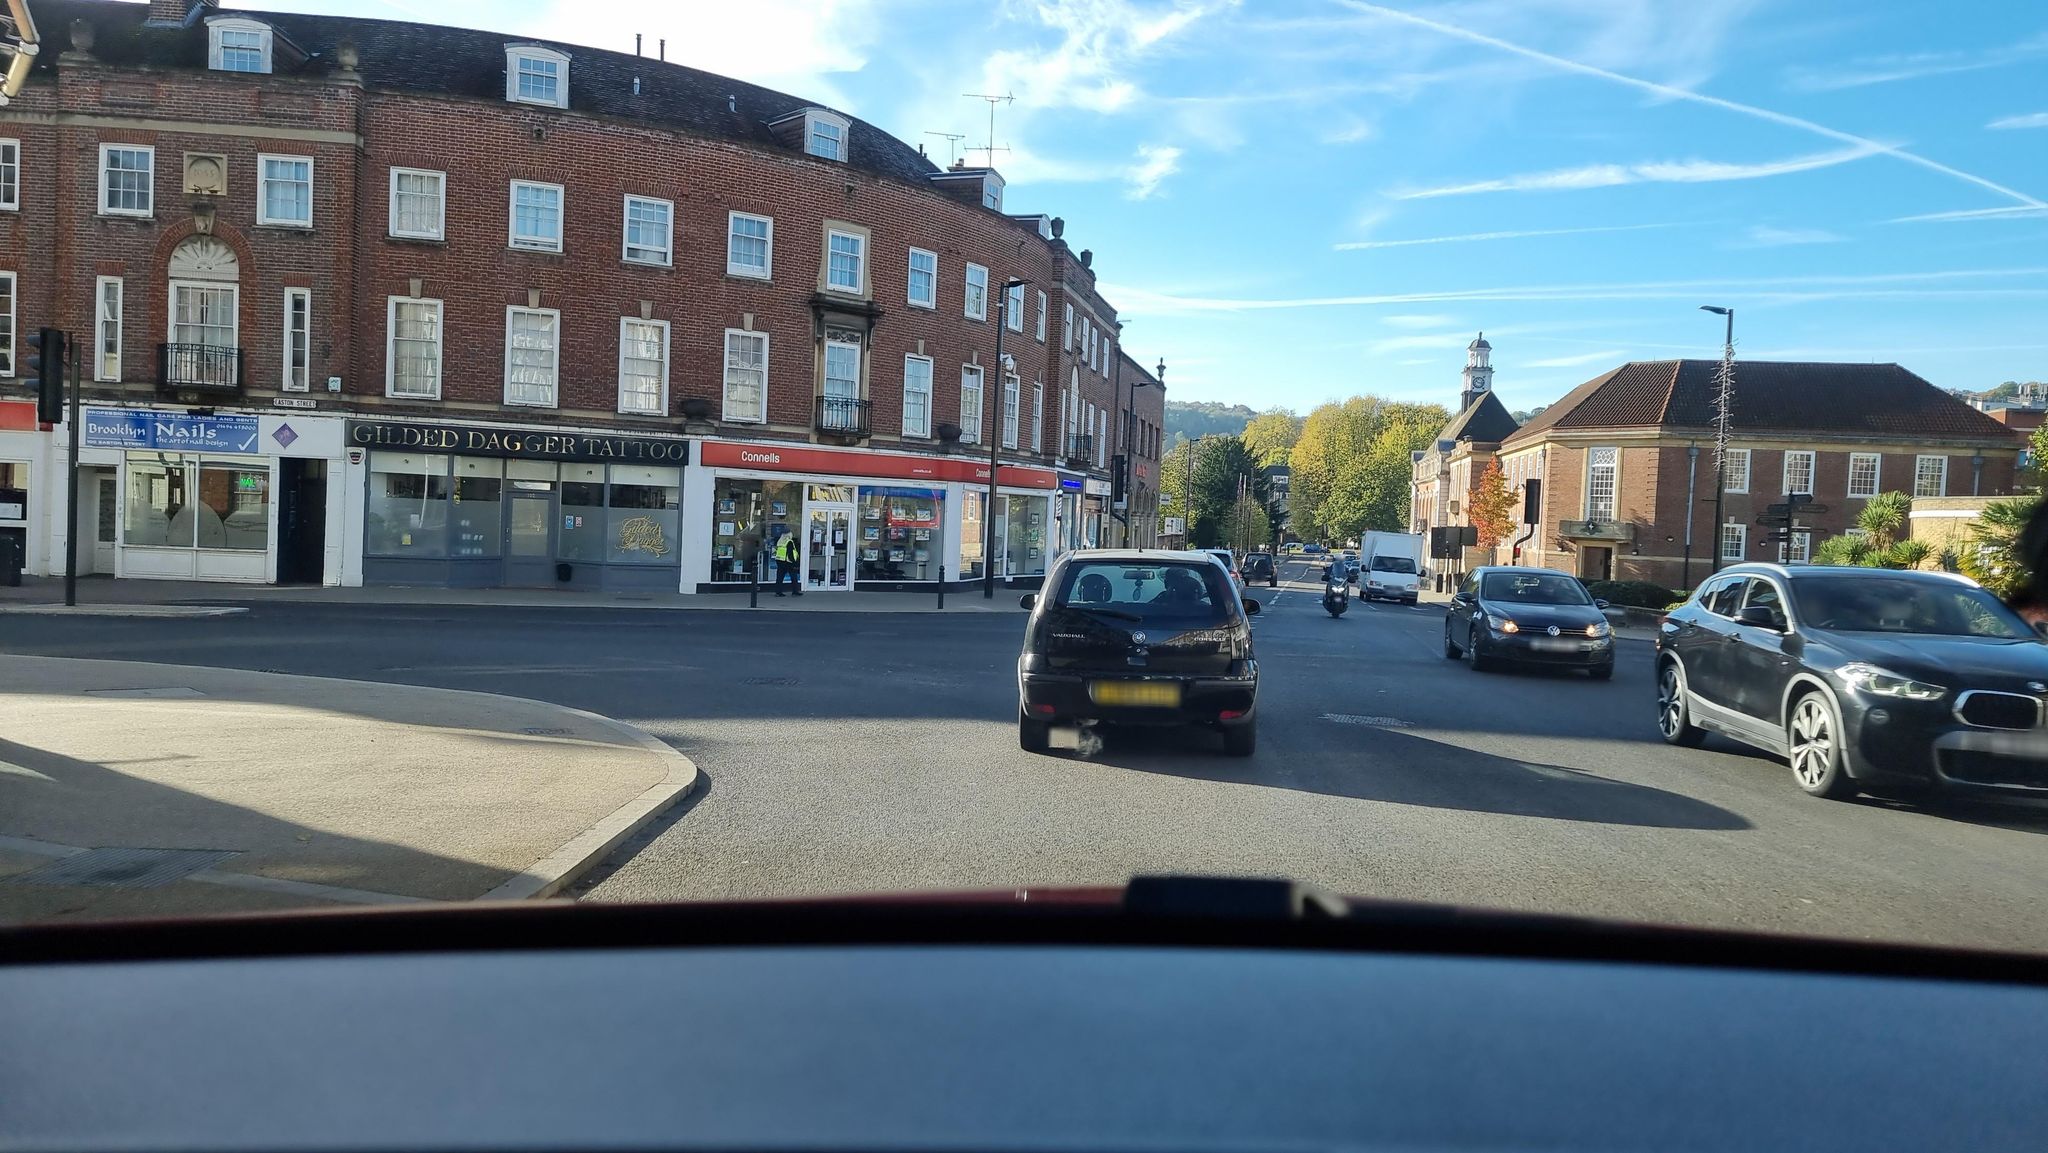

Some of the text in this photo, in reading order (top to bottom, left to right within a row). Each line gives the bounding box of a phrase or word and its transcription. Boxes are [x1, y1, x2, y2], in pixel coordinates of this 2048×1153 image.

[88, 422, 217, 439] Brooklyn Nails
[205, 439, 229, 448] design
[353, 424, 684, 461] GILDED DAGGER TATTOO
[741, 450, 780, 463] Connells
